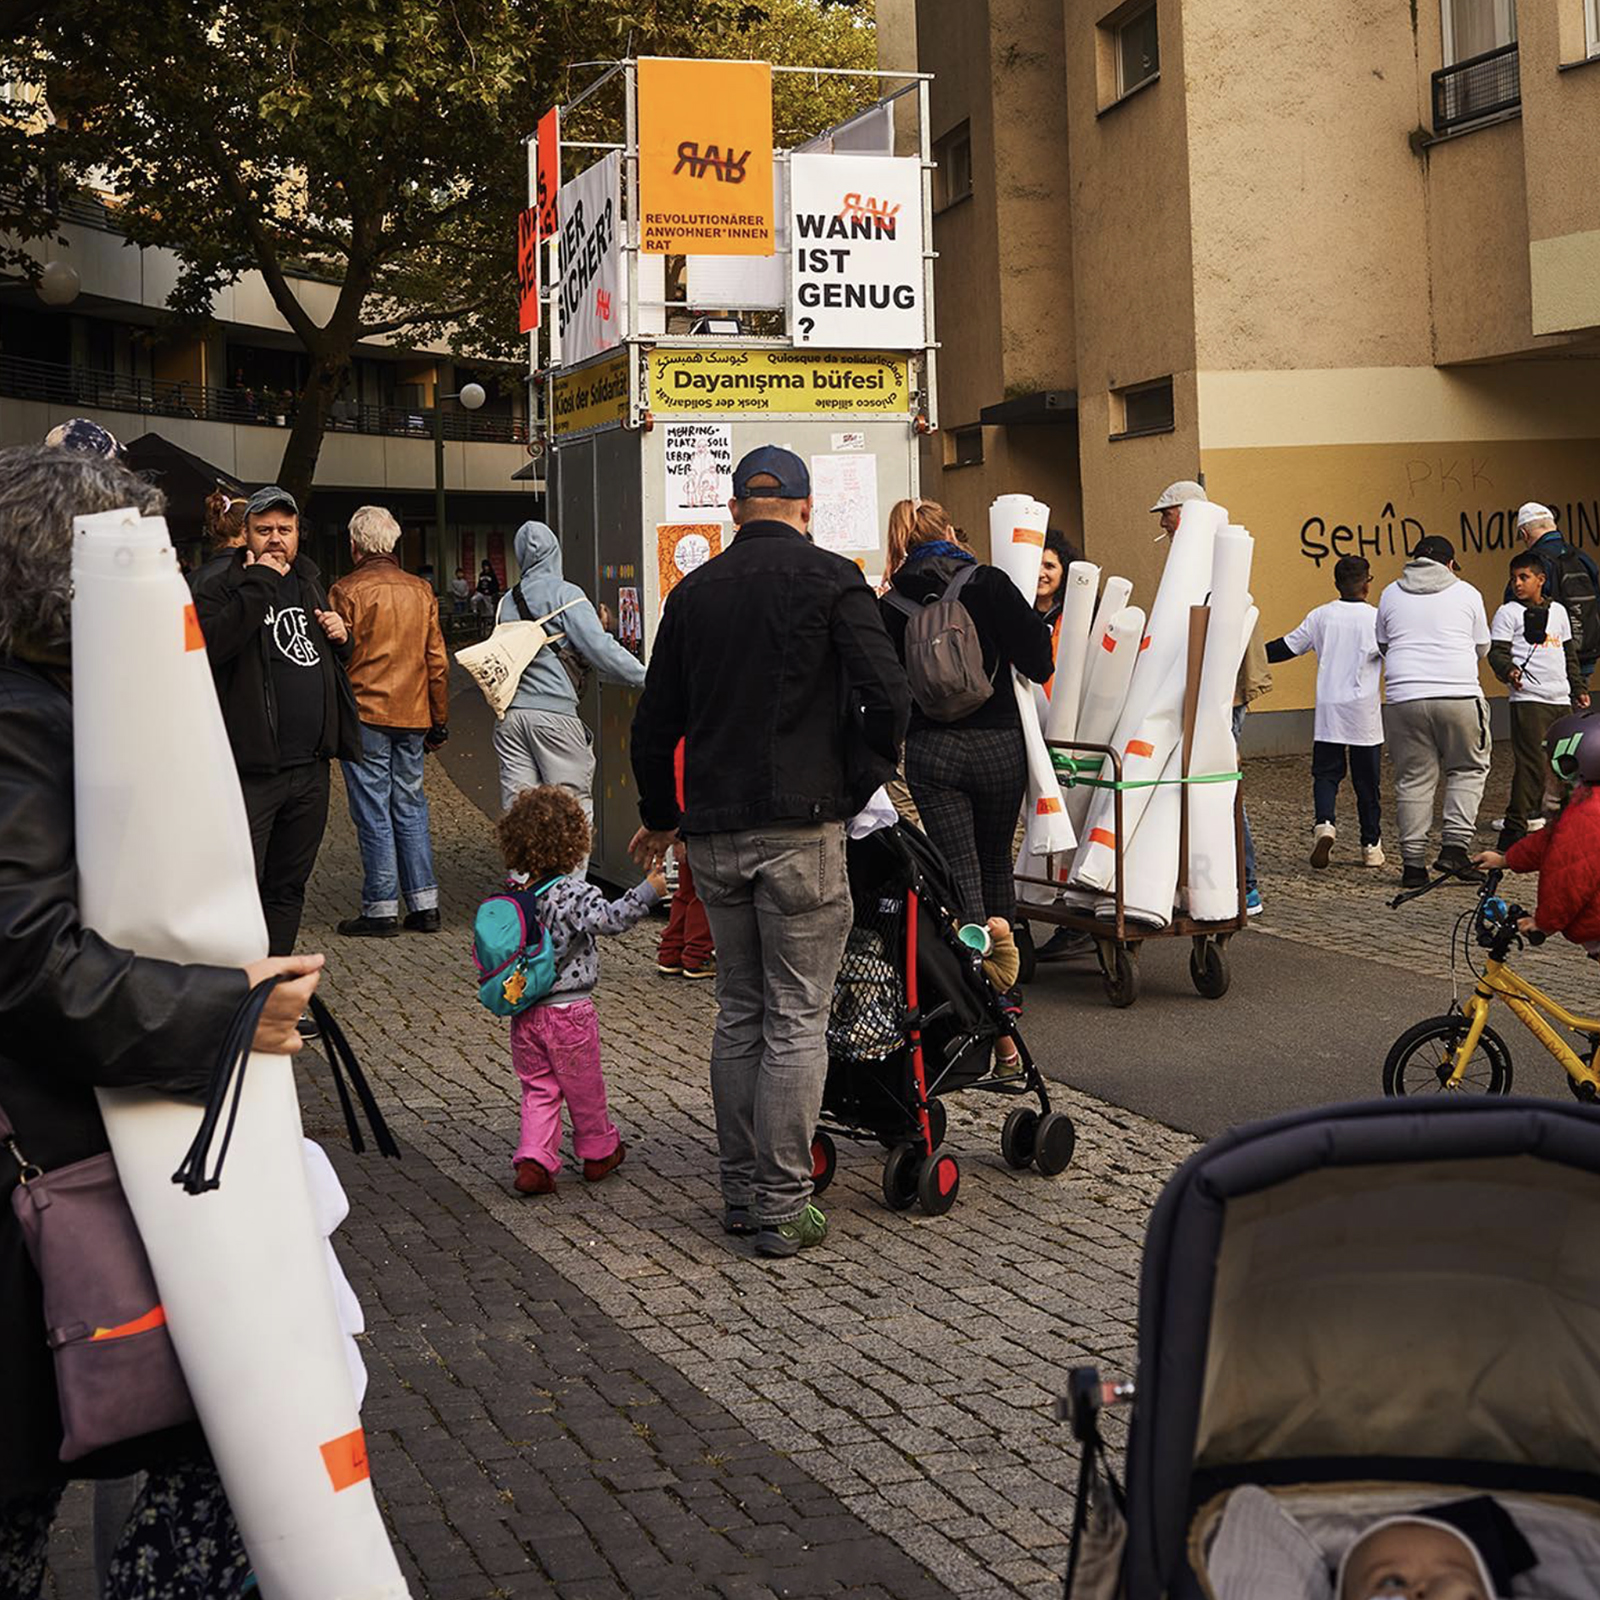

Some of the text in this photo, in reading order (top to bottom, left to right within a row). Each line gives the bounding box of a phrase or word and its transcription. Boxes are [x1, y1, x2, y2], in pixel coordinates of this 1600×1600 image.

[645, 213, 764, 226] REVOLUTIONÄRER
[796, 213, 897, 240] WANN
[645, 240, 672, 250] RAT
[798, 249, 851, 273] IST
[797, 282, 915, 309] GENUG
[798, 317, 815, 341] ?
[674, 369, 884, 394] Dayanışma büfesi
[767, 353, 903, 387] Quiosque da solidariedade
[656, 387, 769, 409] Kiosk der Solidarität
[856, 392, 898, 409] chiosco
[667, 437, 728, 448] PLATZ SOLL
[1405, 456, 1494, 498] PKK
